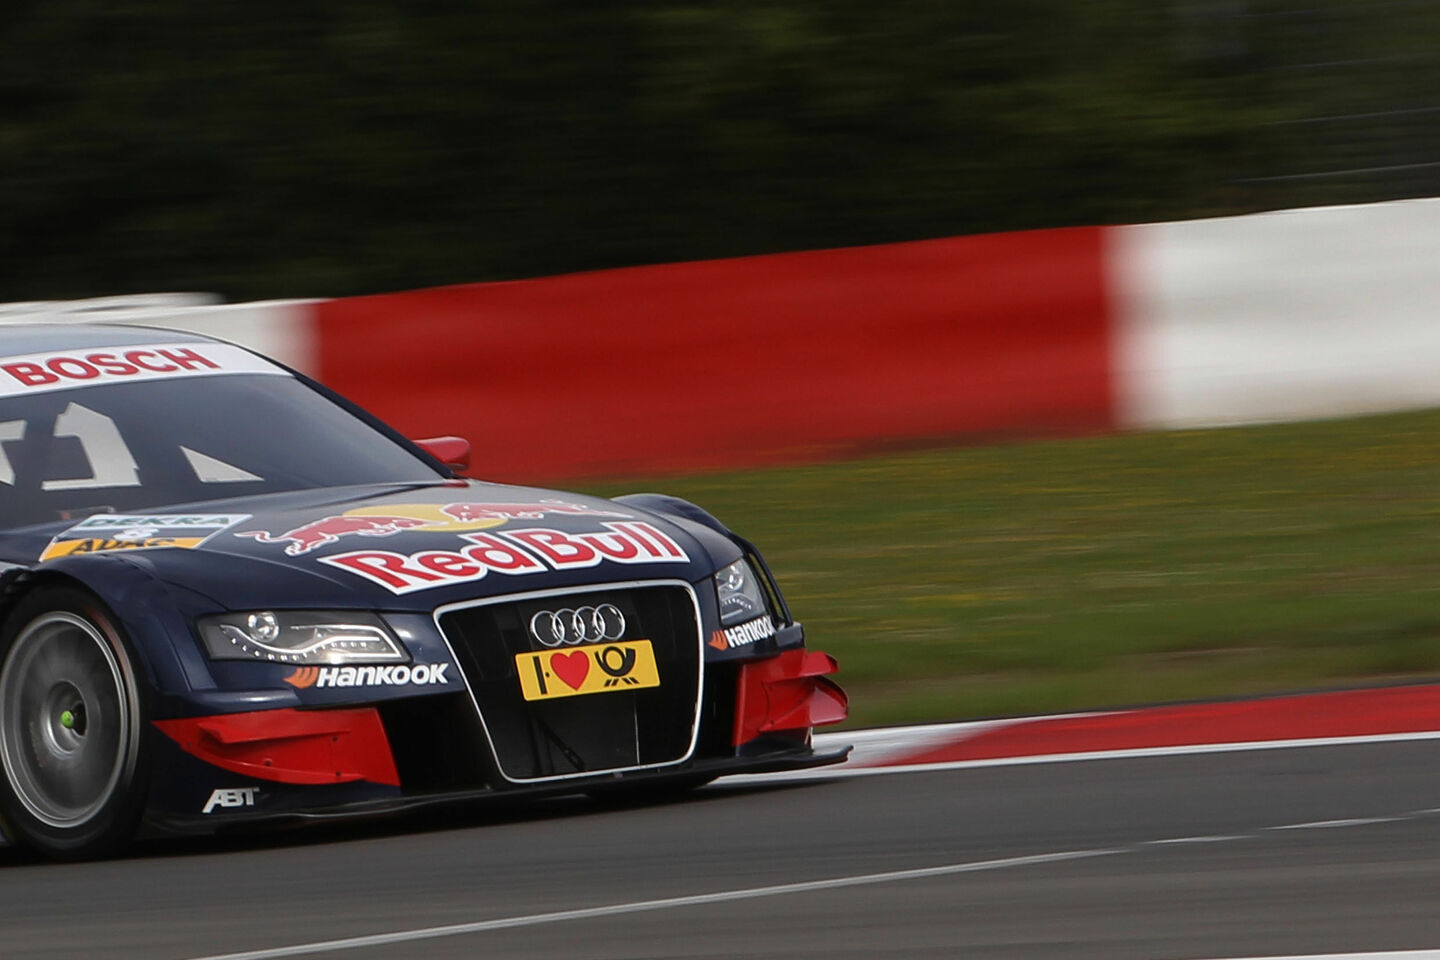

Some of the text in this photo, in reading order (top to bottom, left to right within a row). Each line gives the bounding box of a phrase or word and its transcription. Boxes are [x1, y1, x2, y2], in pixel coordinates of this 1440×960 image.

[0, 347, 223, 387] BOSCH
[80, 516, 230, 527] DEKRA
[202, 787, 260, 813] ABT
